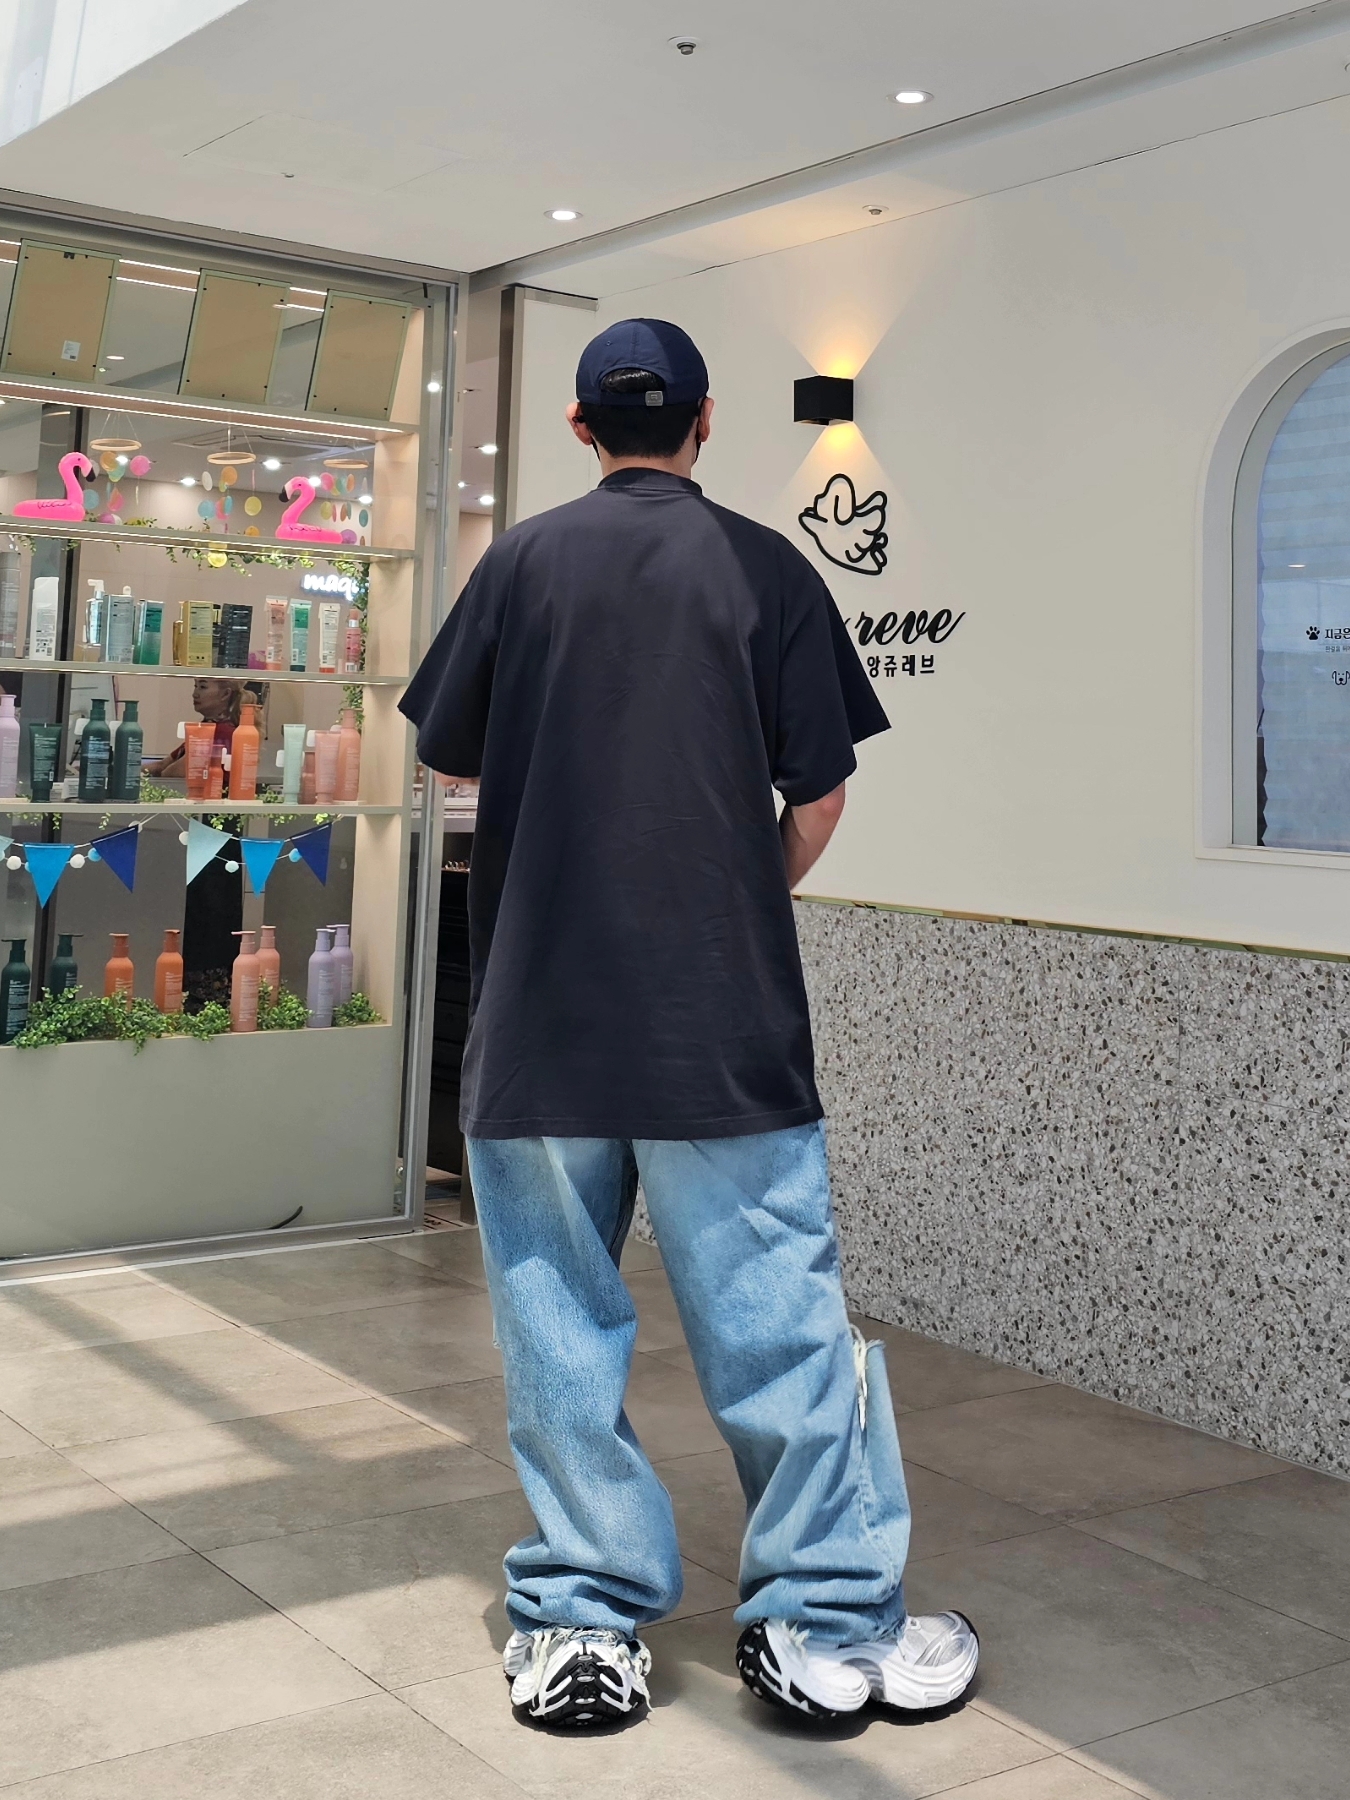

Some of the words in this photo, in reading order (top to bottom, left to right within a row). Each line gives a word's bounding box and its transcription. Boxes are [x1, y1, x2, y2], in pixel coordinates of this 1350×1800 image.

[854, 608, 966, 646] reve
[1324, 627, 1350, 640] 지금은
[867, 654, 935, 678] 앙쥬레브
